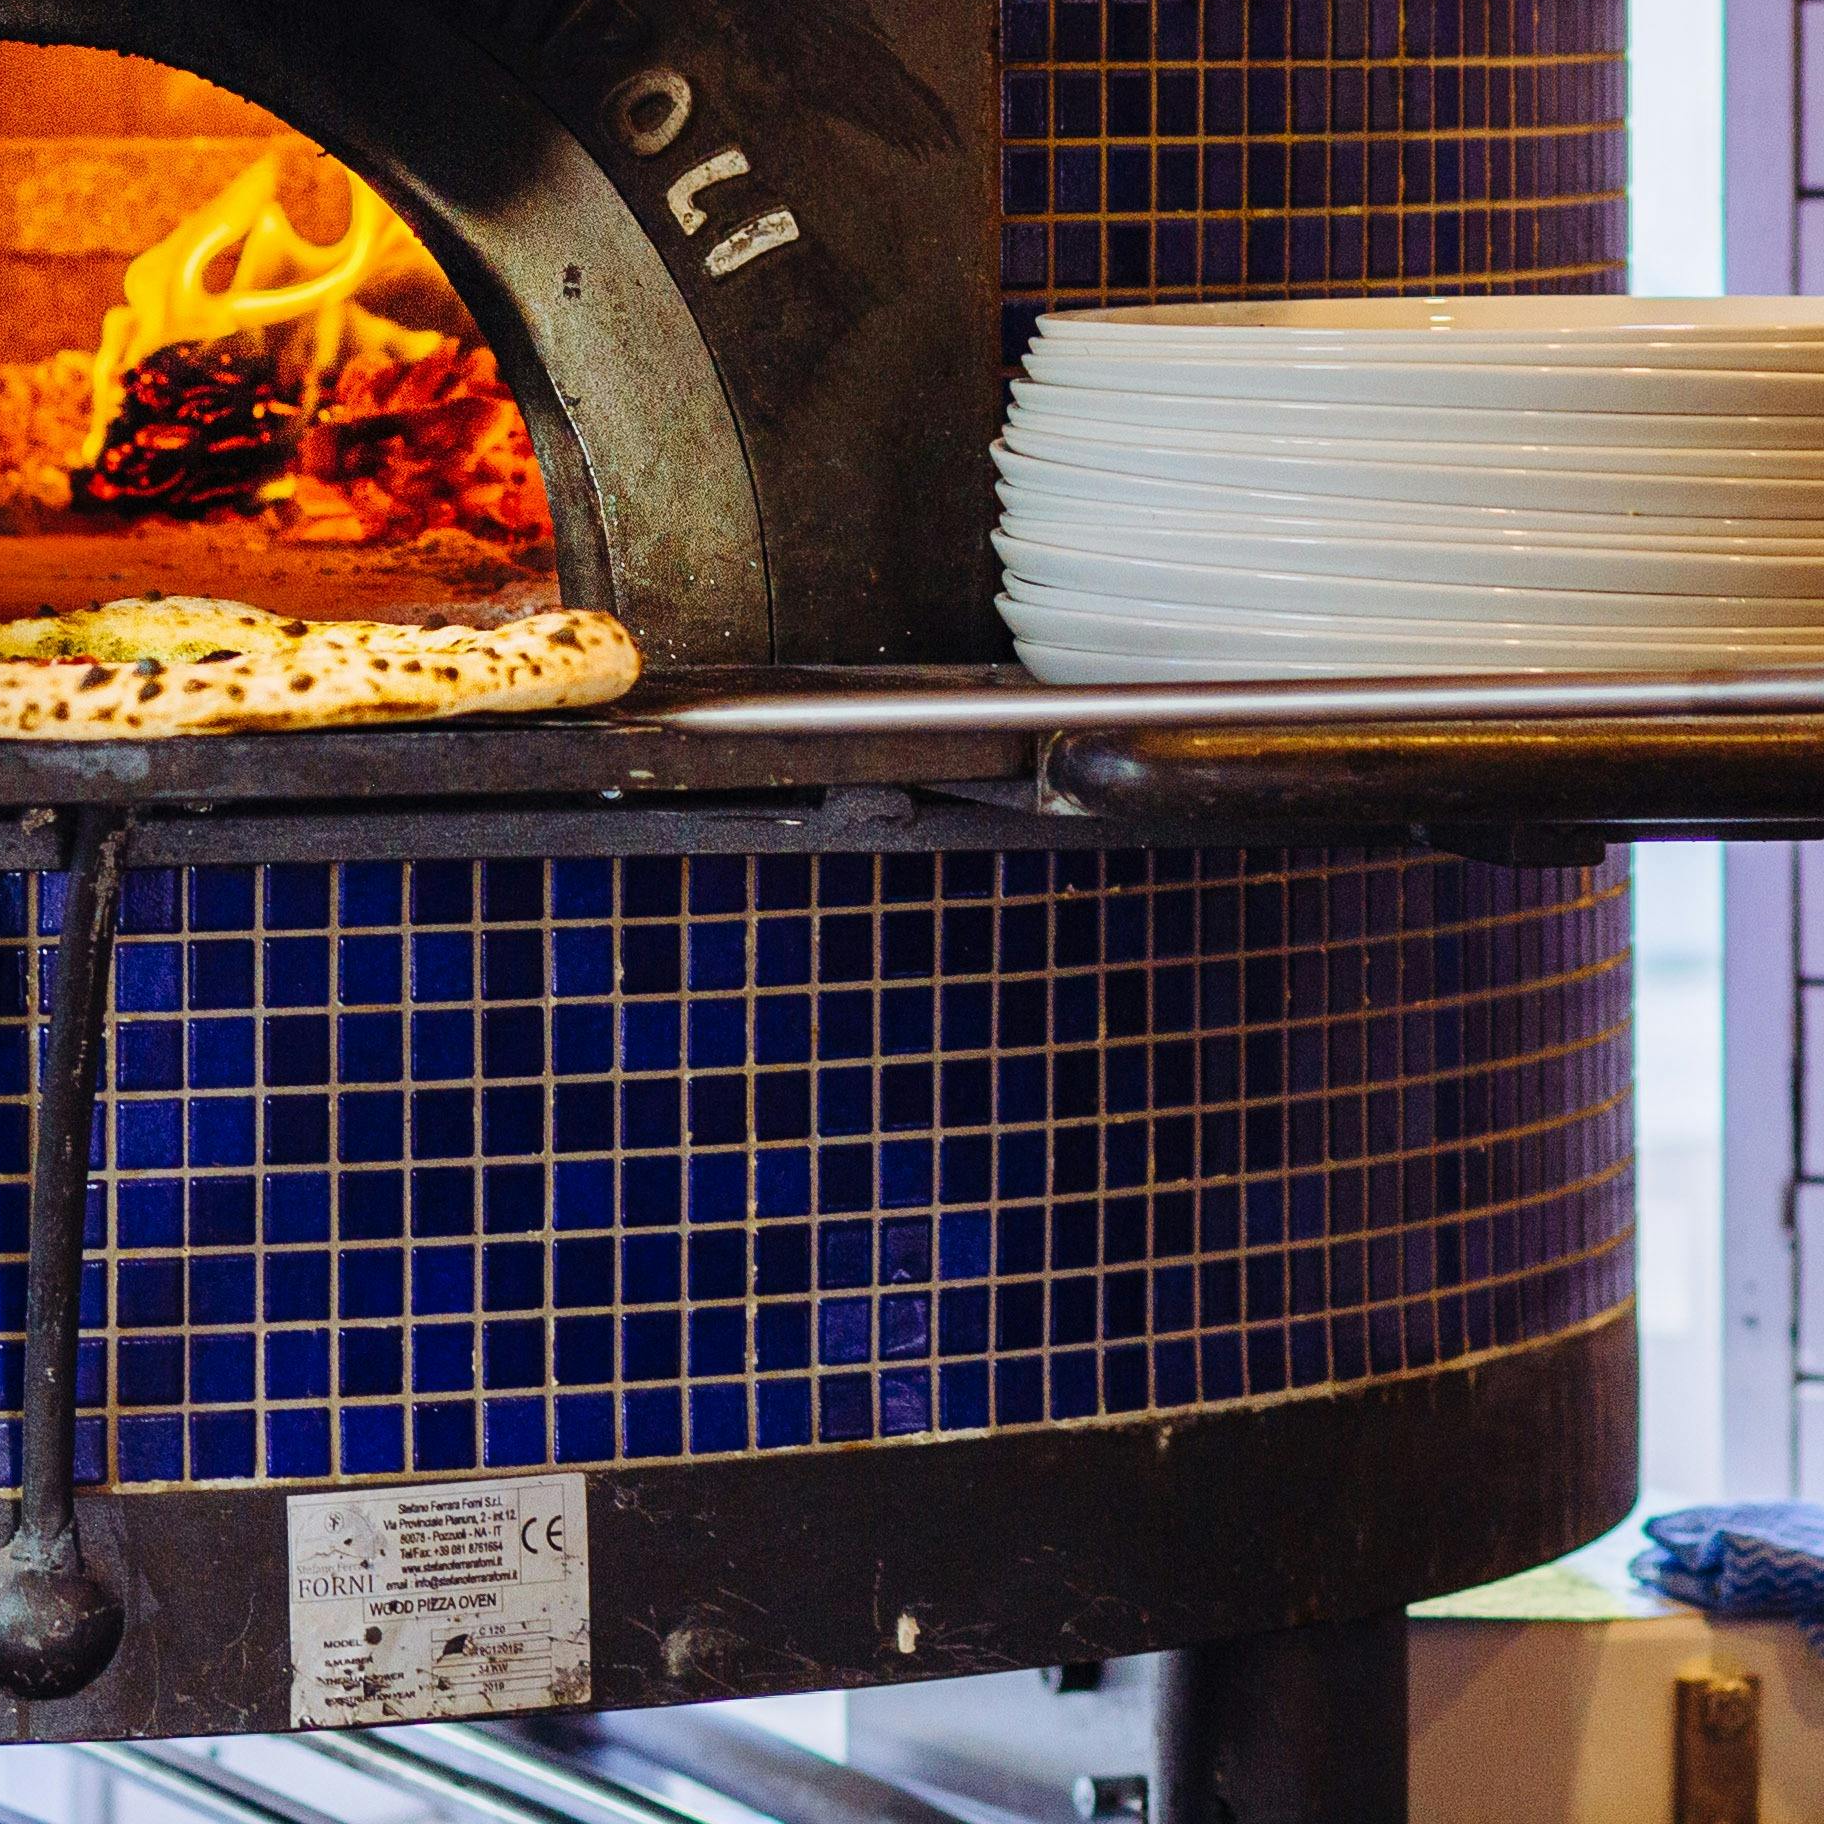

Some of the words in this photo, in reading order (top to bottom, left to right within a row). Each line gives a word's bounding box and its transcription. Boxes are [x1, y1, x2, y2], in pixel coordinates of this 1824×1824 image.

[398, 1503, 429, 1514] Stefano
[431, 1500, 461, 1511] Ferrara
[462, 1497, 483, 1509] Forni
[383, 1519, 397, 1530] Via
[399, 1517, 444, 1529] Provinciale
[481, 1511, 486, 1523] 2
[433, 1528, 467, 1541] Pozzuoli
[474, 1527, 487, 1538] NA
[494, 1525, 502, 1537] IT
[521, 1514, 563, 1555] CE
[433, 1544, 450, 1556] +39
[451, 1543, 466, 1555] 081
[298, 1574, 374, 1598] FORNI
[369, 1598, 414, 1617] WOOD
[418, 1595, 457, 1612] PIZZA
[459, 1593, 497, 1609] OVEN
[323, 1638, 363, 1649] MODEL
[489, 1625, 506, 1634] 120
